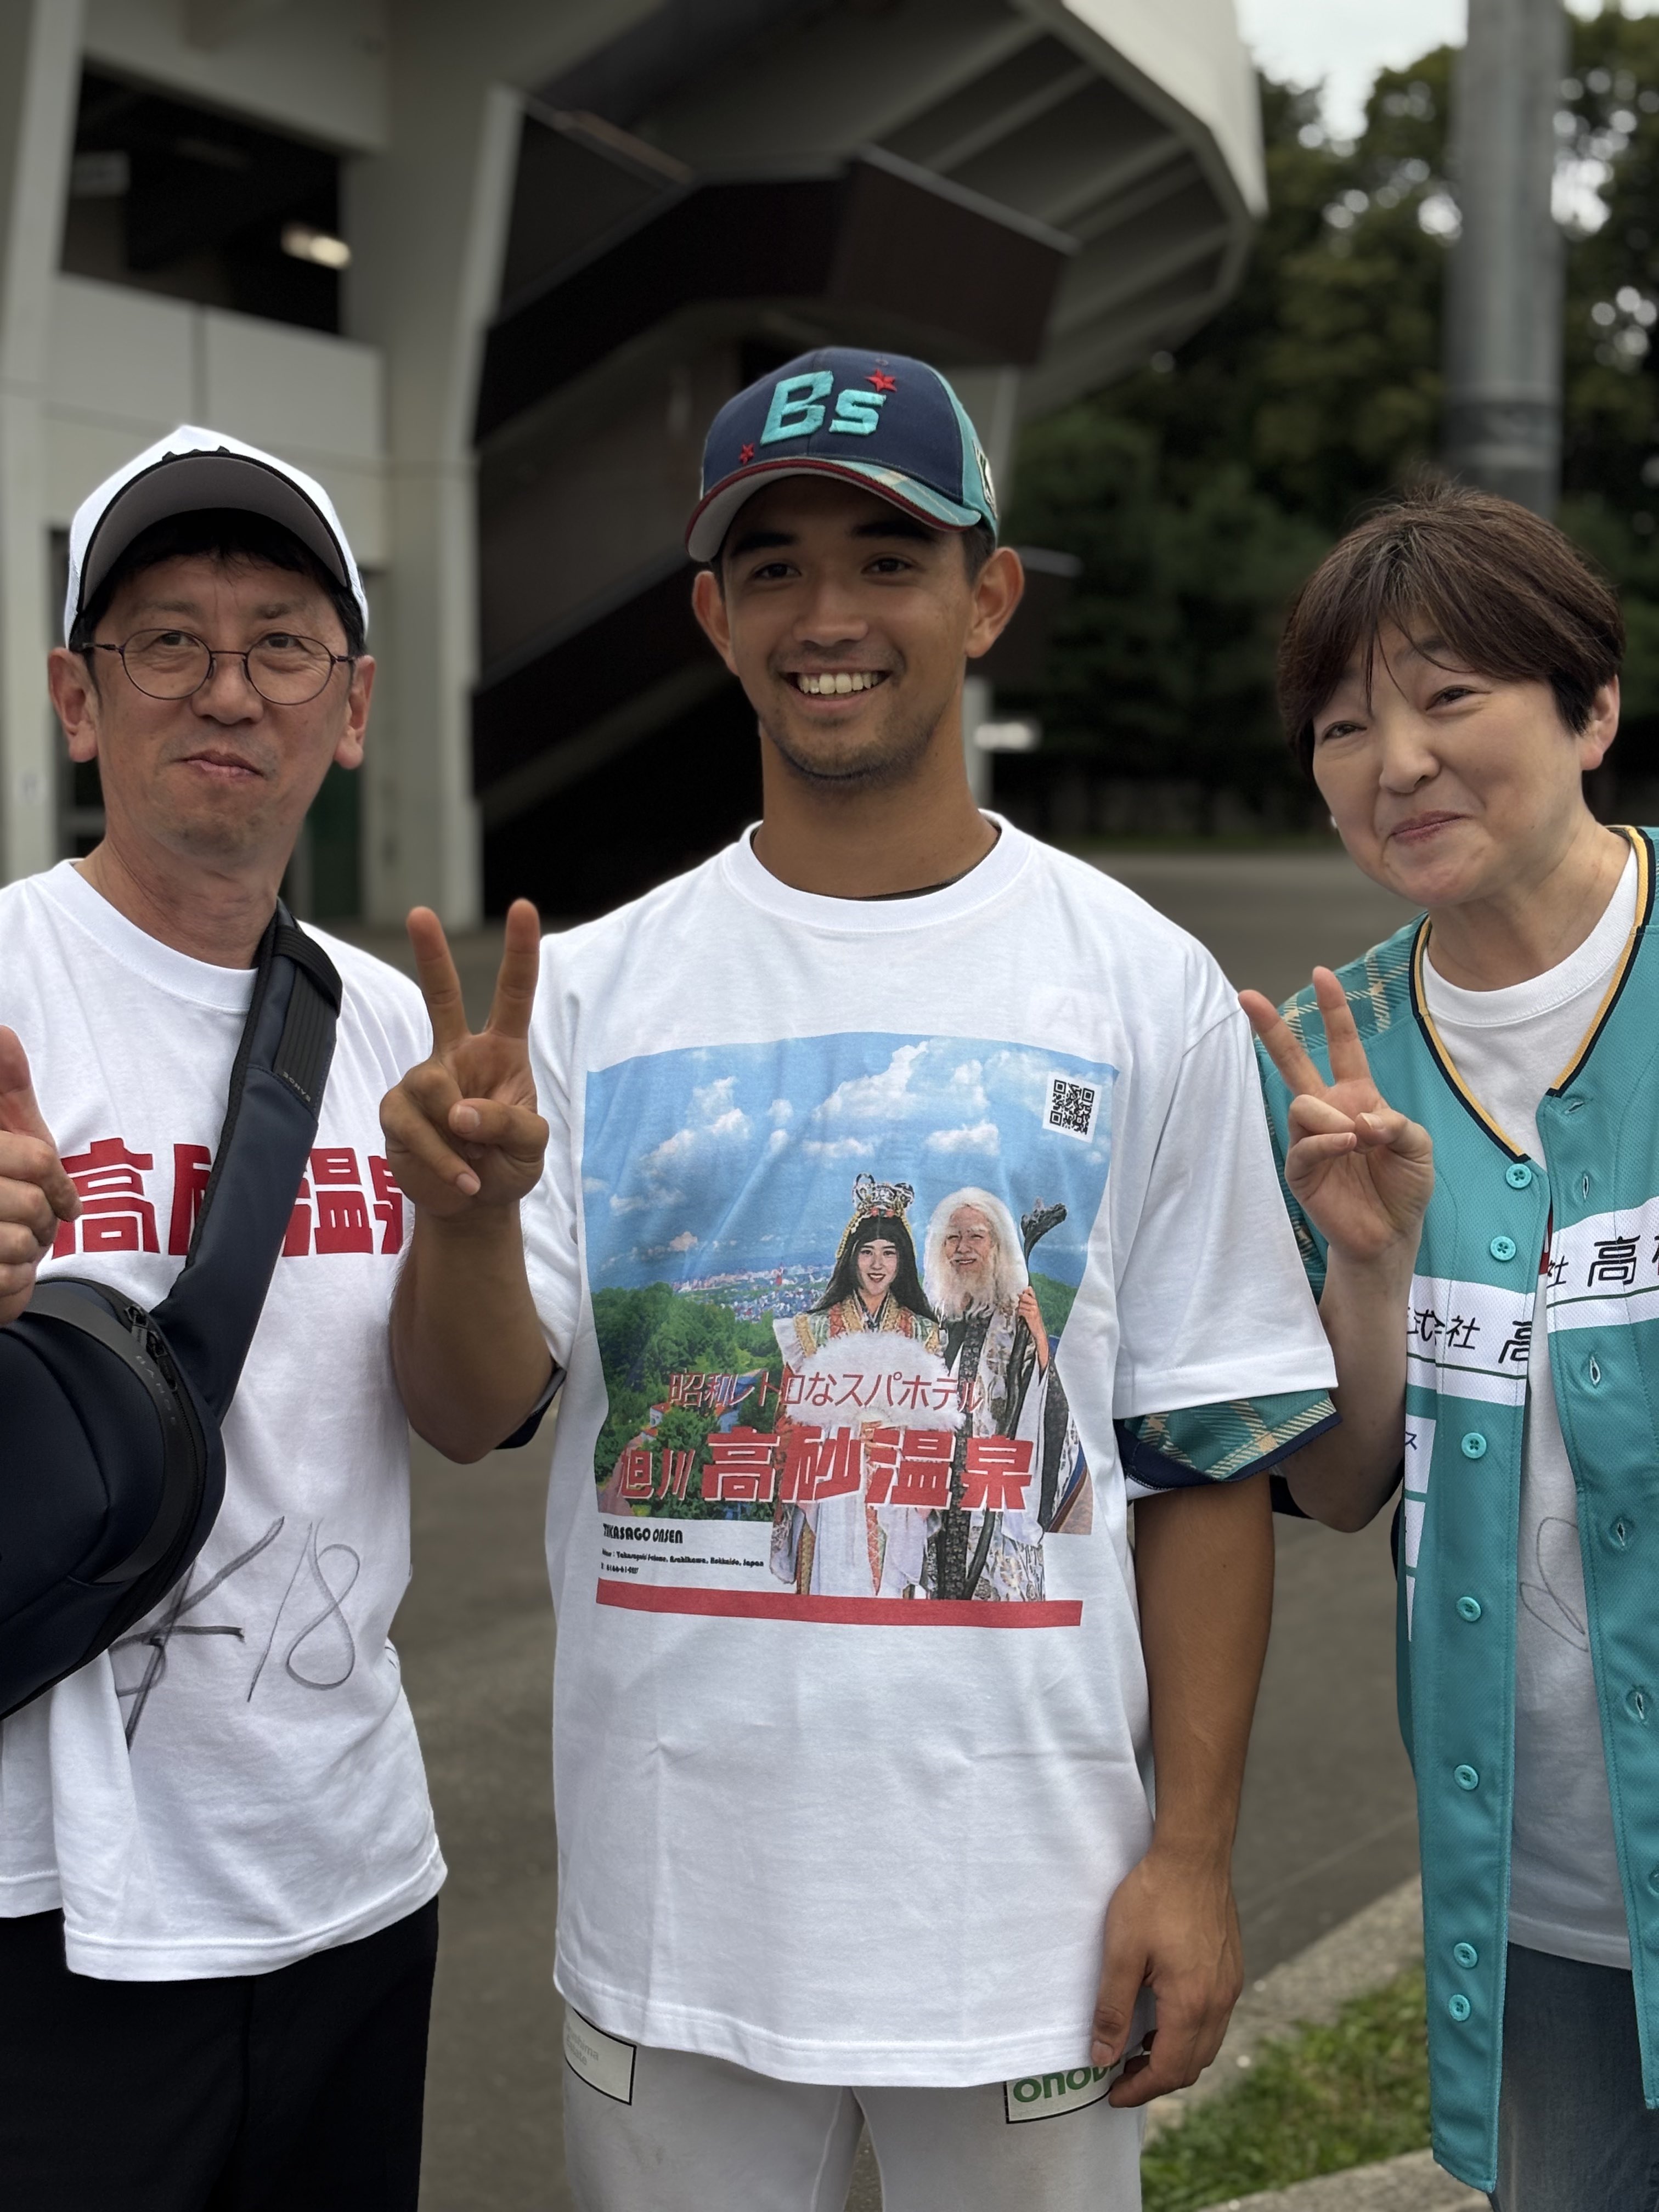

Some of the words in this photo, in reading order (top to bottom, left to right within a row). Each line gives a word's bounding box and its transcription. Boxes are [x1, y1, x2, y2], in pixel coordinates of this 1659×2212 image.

[760, 370, 887, 445] Bs
[669, 1372, 985, 1413] 昭和レトロなスパホテル
